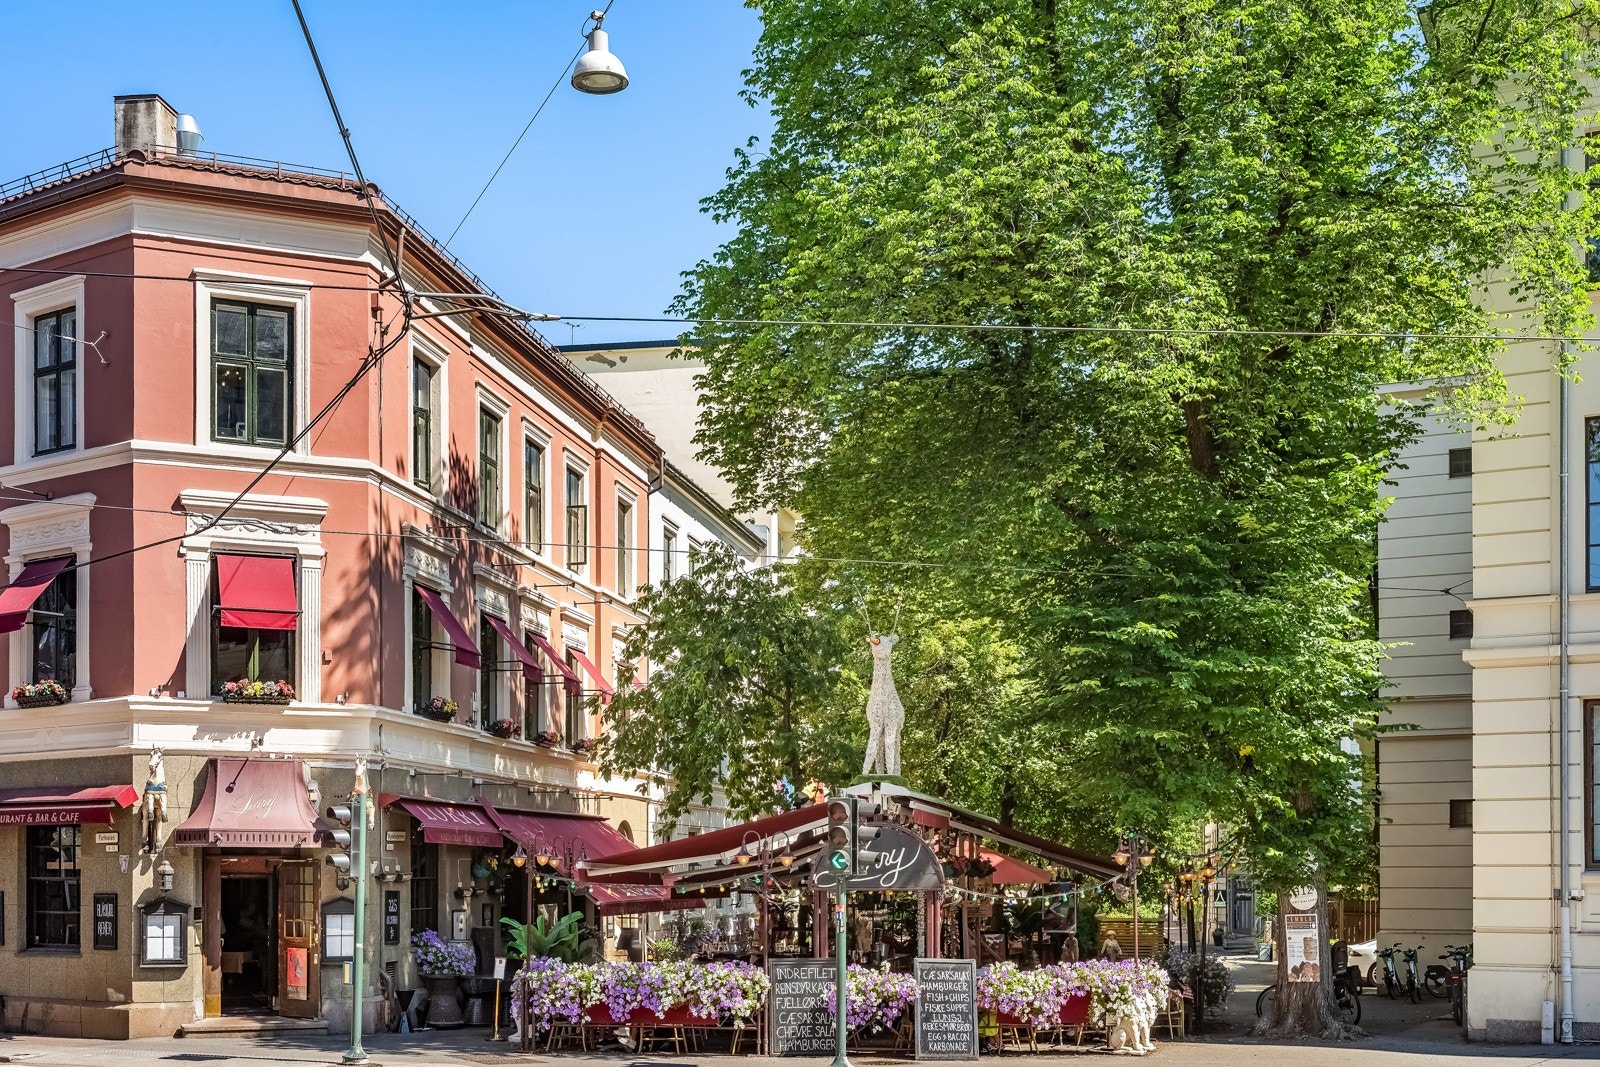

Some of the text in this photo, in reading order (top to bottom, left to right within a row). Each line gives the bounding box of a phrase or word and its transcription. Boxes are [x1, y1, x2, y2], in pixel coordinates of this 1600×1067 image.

[27, 813, 33, 823] &
[35, 813, 49, 822] BAR
[50, 812, 57, 822] &
[776, 967, 837, 980] INDREFILET
[922, 970, 970, 982] CÆSARSALAT
[775, 981, 829, 995] REINSDYRKAK
[922, 981, 969, 992] HAMBURGER
[775, 997, 830, 1009] FJELLØRRE
[926, 993, 944, 1002] FISH
[949, 993, 970, 1002] CHIPS
[924, 1003, 969, 1013] FISKESUPPE
[779, 1012, 835, 1025] CÆSAR SALA
[932, 1013, 962, 1022] LUNSJ
[815, 1025, 836, 1037] SALA
[927, 1032, 942, 1041] EGG
[947, 1032, 970, 1042] BACON
[779, 1039, 837, 1051] HAMBURGER
[928, 1042, 968, 1052] KARBONADE
